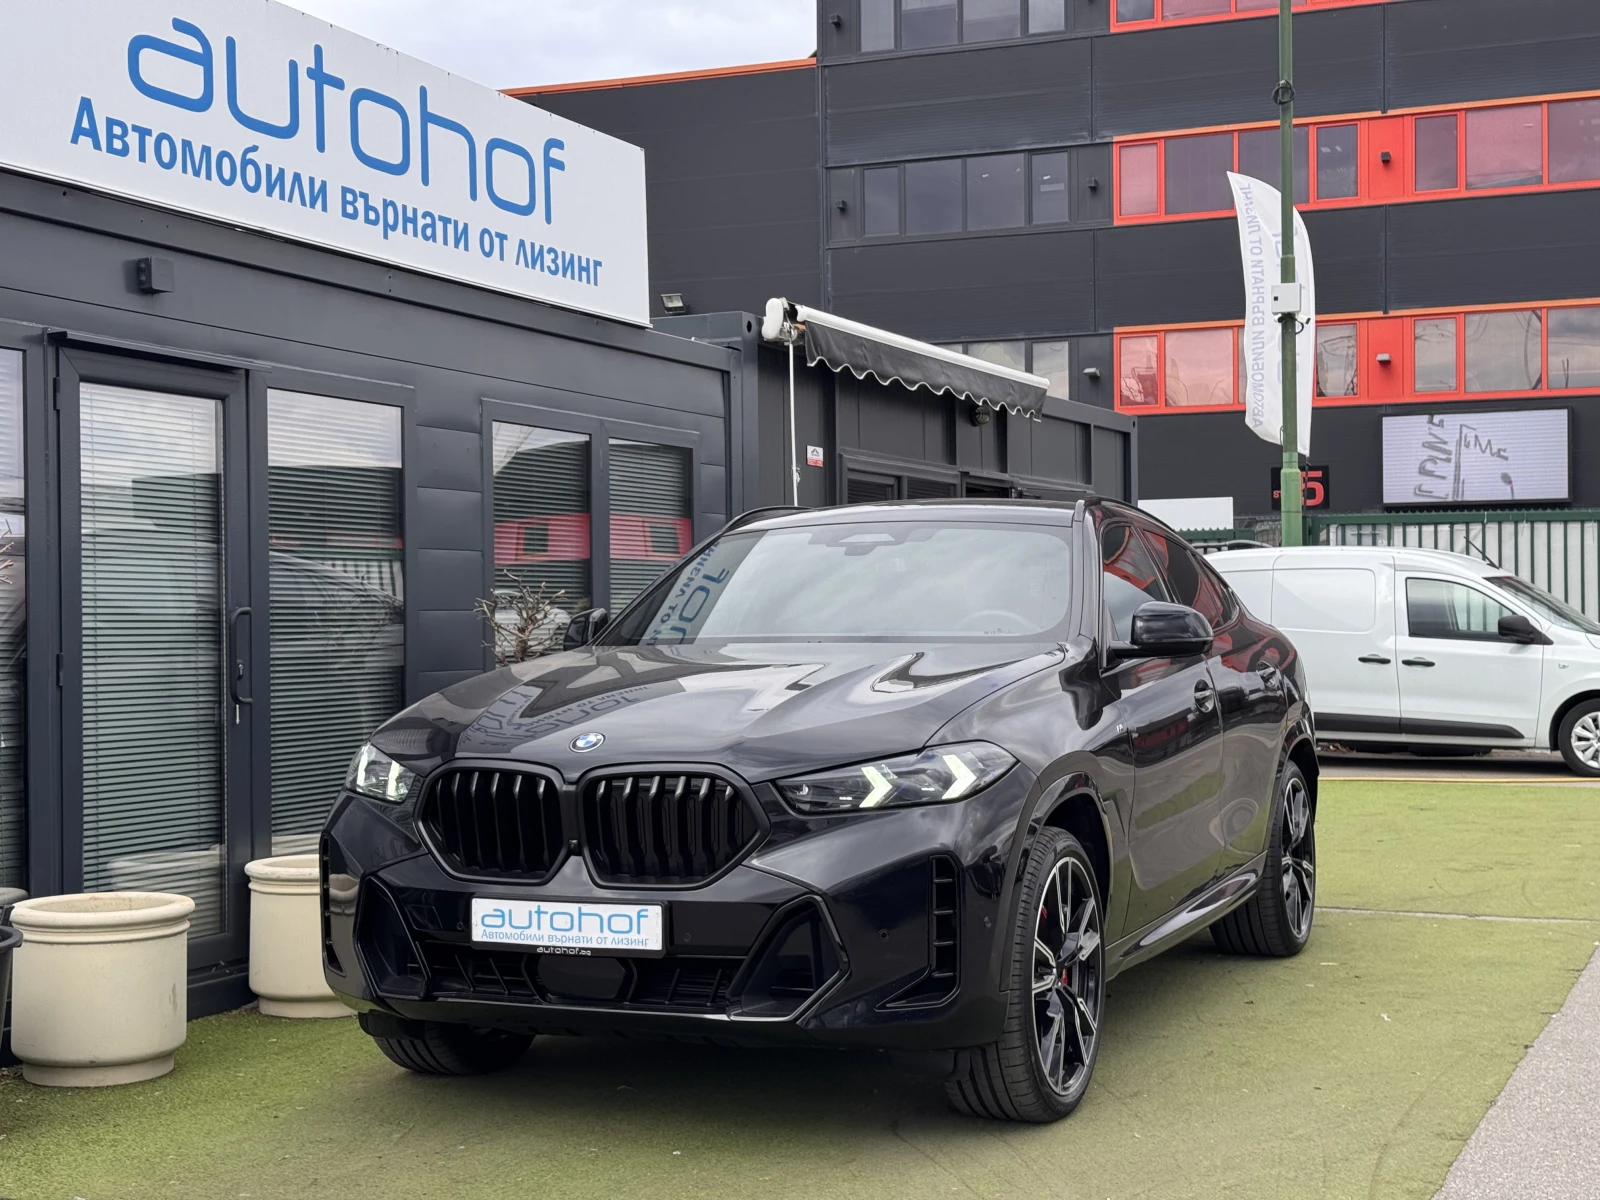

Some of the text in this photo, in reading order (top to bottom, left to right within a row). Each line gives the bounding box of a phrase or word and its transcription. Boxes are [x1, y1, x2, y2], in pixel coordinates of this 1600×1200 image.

[127, 16, 566, 225] autohof
[70, 95, 603, 287] Автомобили върнати от лизинг
[1299, 470, 1325, 507] 5
[480, 904, 649, 935] autohof
[481, 928, 649, 948] Автомобили върнати от лизинг
[536, 945, 592, 957] autohof.bg
